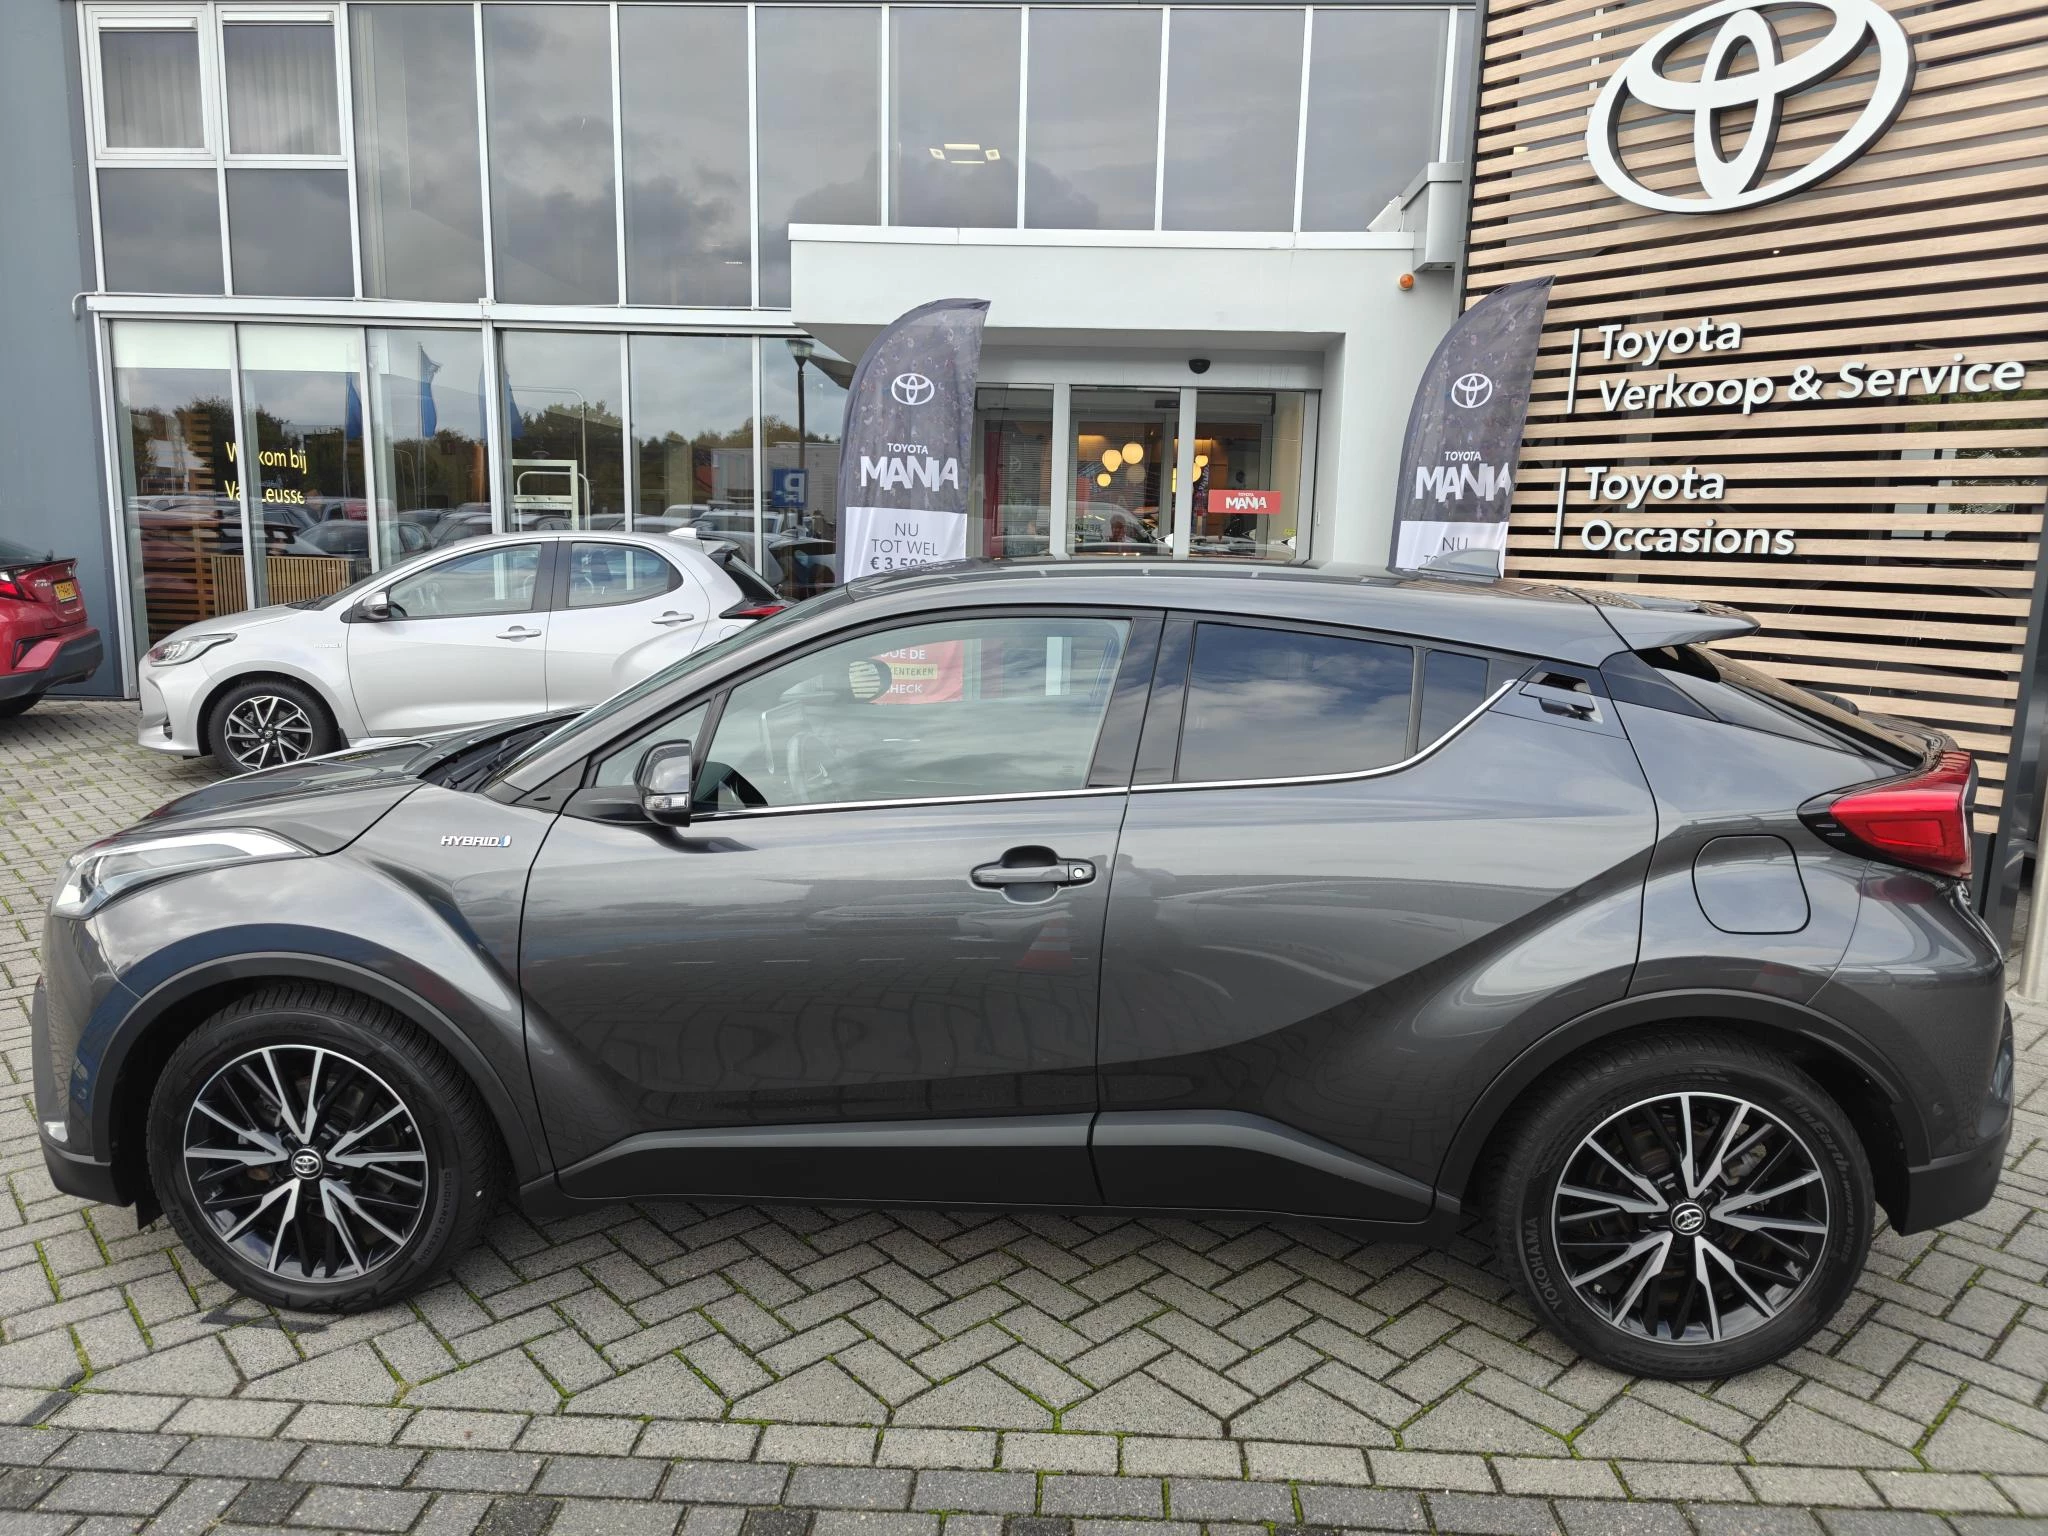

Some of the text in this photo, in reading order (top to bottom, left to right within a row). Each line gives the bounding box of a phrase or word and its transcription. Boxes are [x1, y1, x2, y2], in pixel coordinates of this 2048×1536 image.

[1600, 318, 1742, 366] Toyota
[1600, 353, 2027, 415] Verkoop & Service
[887, 443, 929, 455] TOYOTA
[1444, 450, 1483, 462] TOYOTA
[290, 448, 307, 474] bij
[860, 455, 960, 492] MANIA
[1415, 462, 1512, 503] MANIA
[1585, 466, 1727, 510] Toyota
[1225, 496, 1268, 510] MANIA
[895, 522, 919, 537] NU
[1581, 519, 1797, 556] Occasions
[871, 539, 939, 556] TOT WEL
[909, 649, 926, 660] DE
[890, 667, 933, 676] ENTEKEN
[886, 684, 923, 695] HECK
[440, 835, 501, 847] HYBRID
[1525, 1217, 1563, 1310] YOKOHAMA
